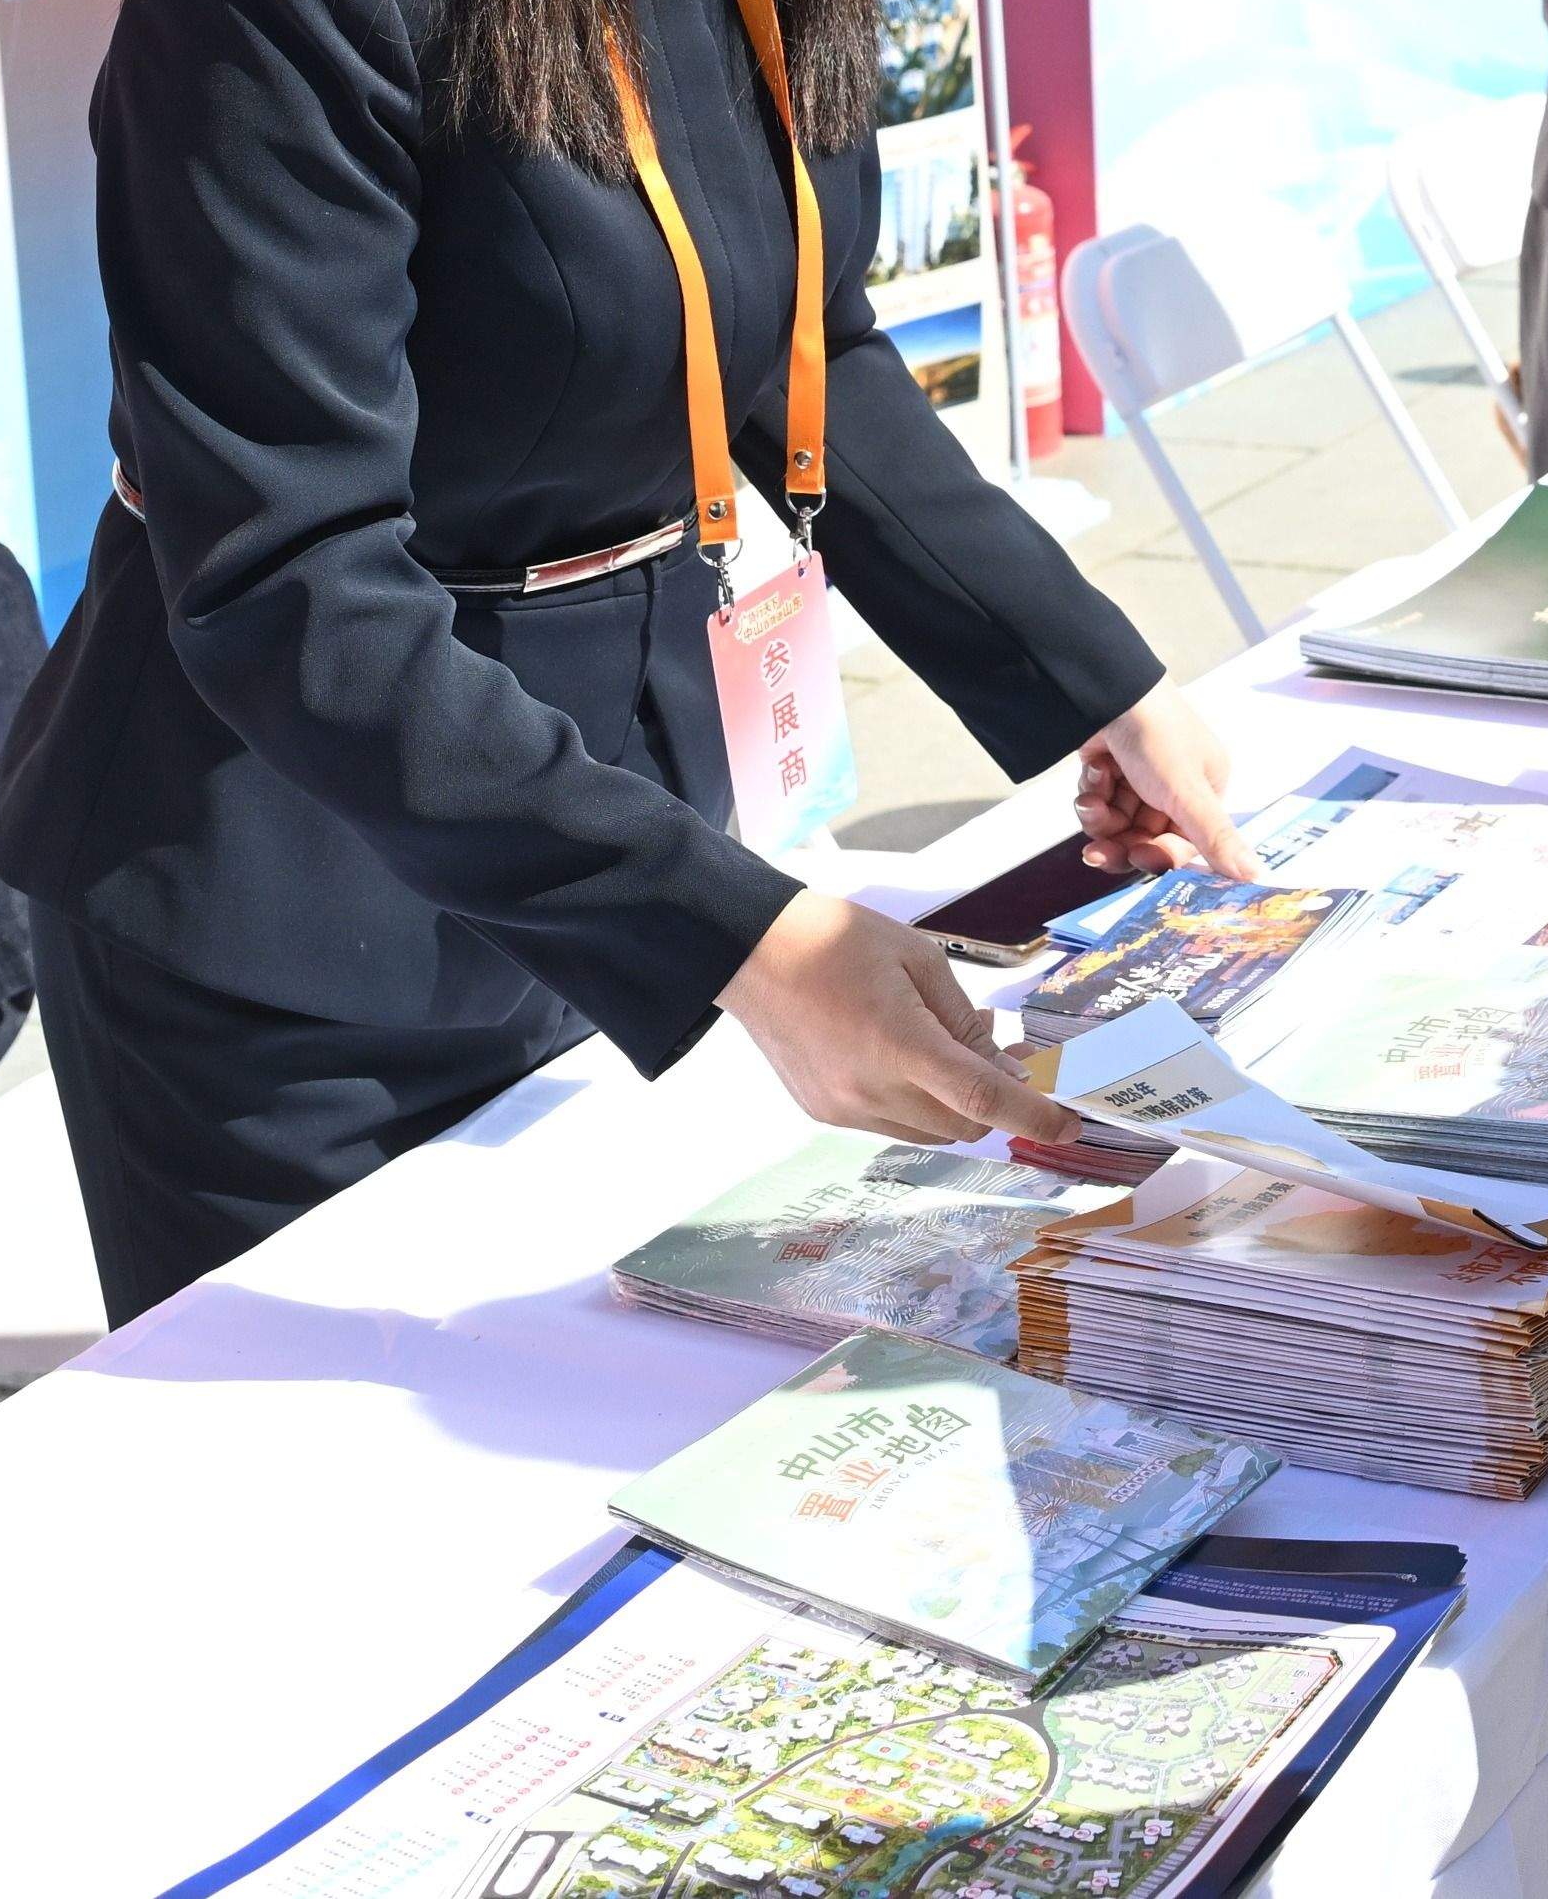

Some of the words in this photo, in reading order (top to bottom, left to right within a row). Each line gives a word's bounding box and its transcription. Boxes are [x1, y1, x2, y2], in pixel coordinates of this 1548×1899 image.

[762, 641, 808, 798] 参展商
[1377, 1015, 1451, 1064] 中山市
[1104, 1081, 1158, 1108] 2026年
[777, 1405, 895, 1481] 中山市
[868, 1471, 911, 1511] ZHONG
[913, 1440, 962, 1467] SHAN
